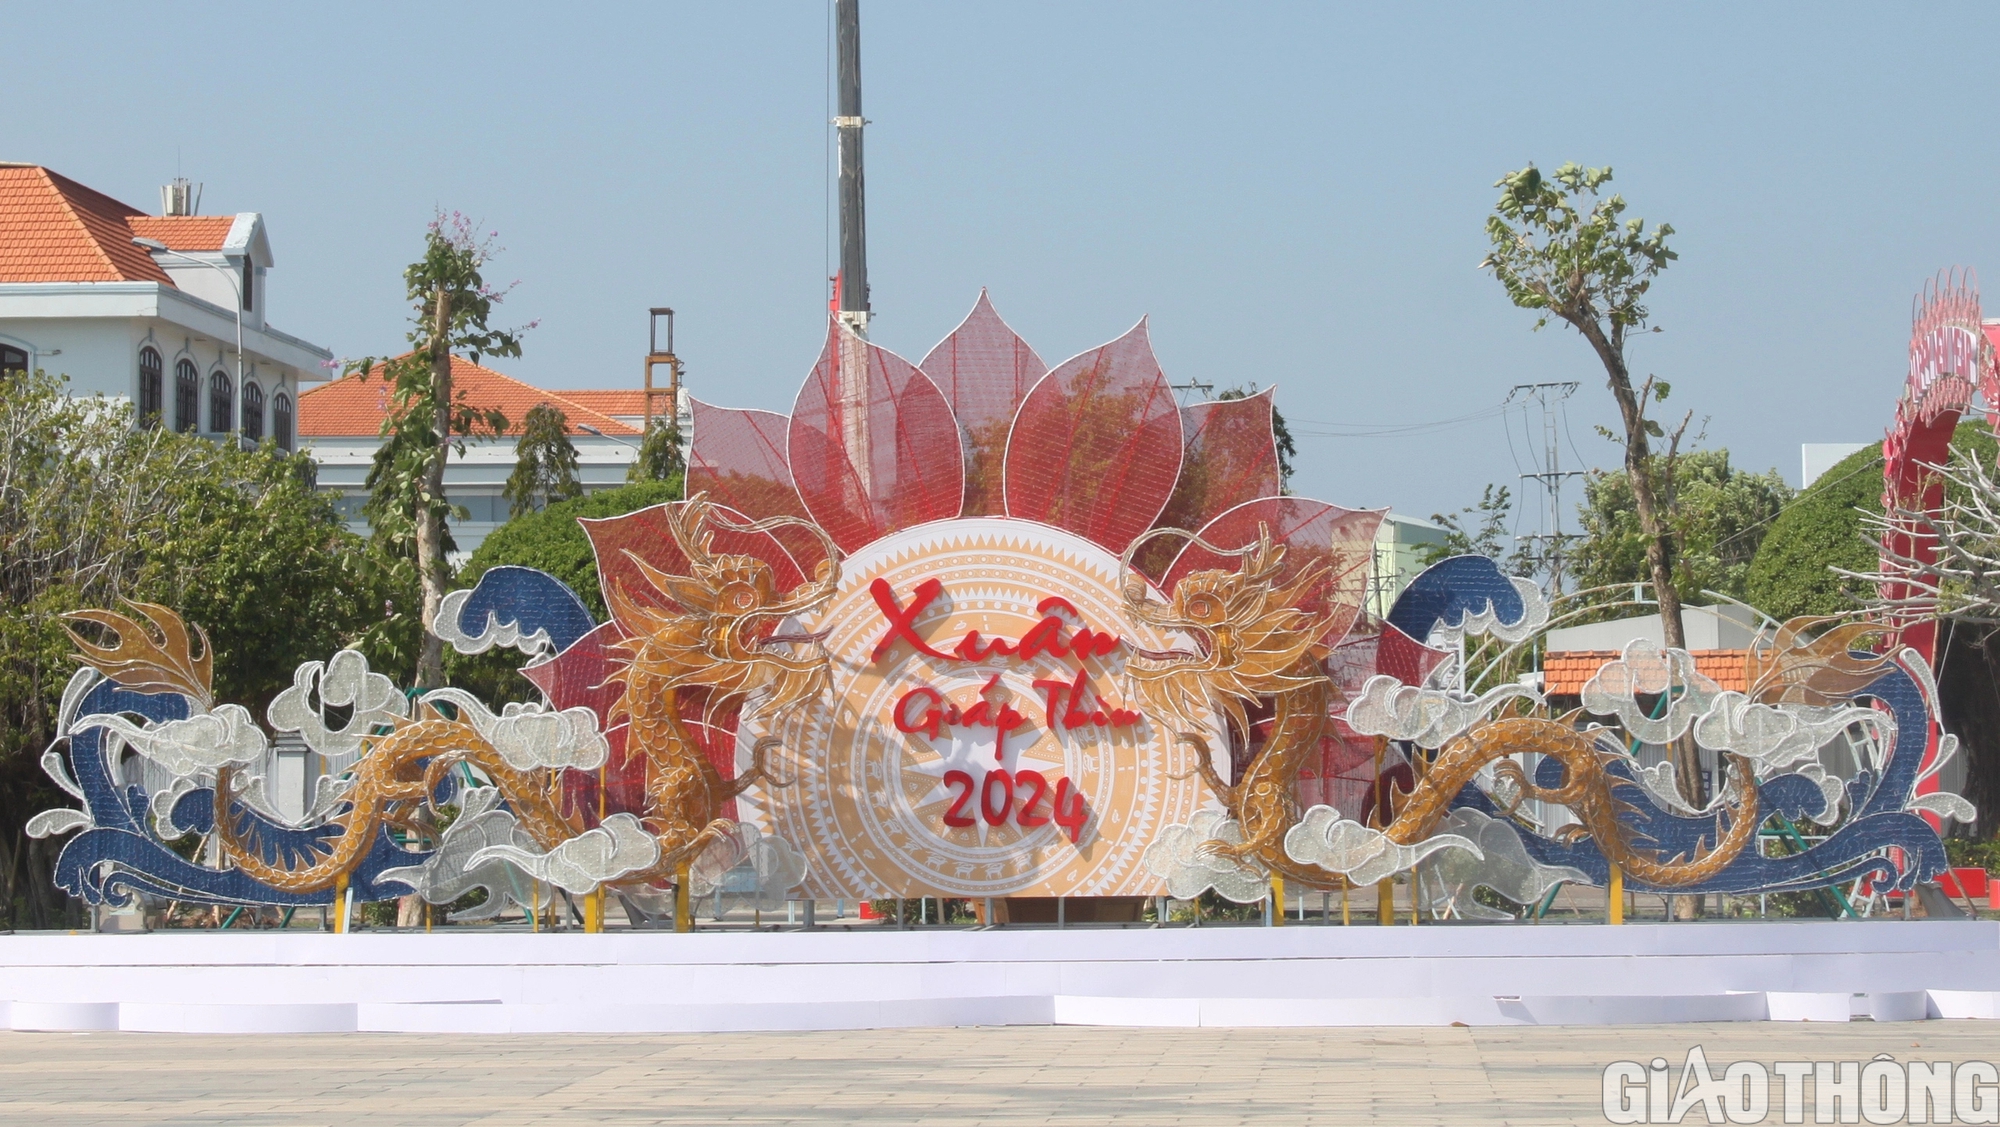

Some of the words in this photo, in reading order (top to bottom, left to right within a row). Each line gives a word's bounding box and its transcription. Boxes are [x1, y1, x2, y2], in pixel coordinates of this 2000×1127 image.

[870, 578, 1120, 663] Xuân
[894, 673, 1028, 760] Giáp
[1032, 668, 1141, 730] Thìn
[943, 769, 1088, 843] 2024
